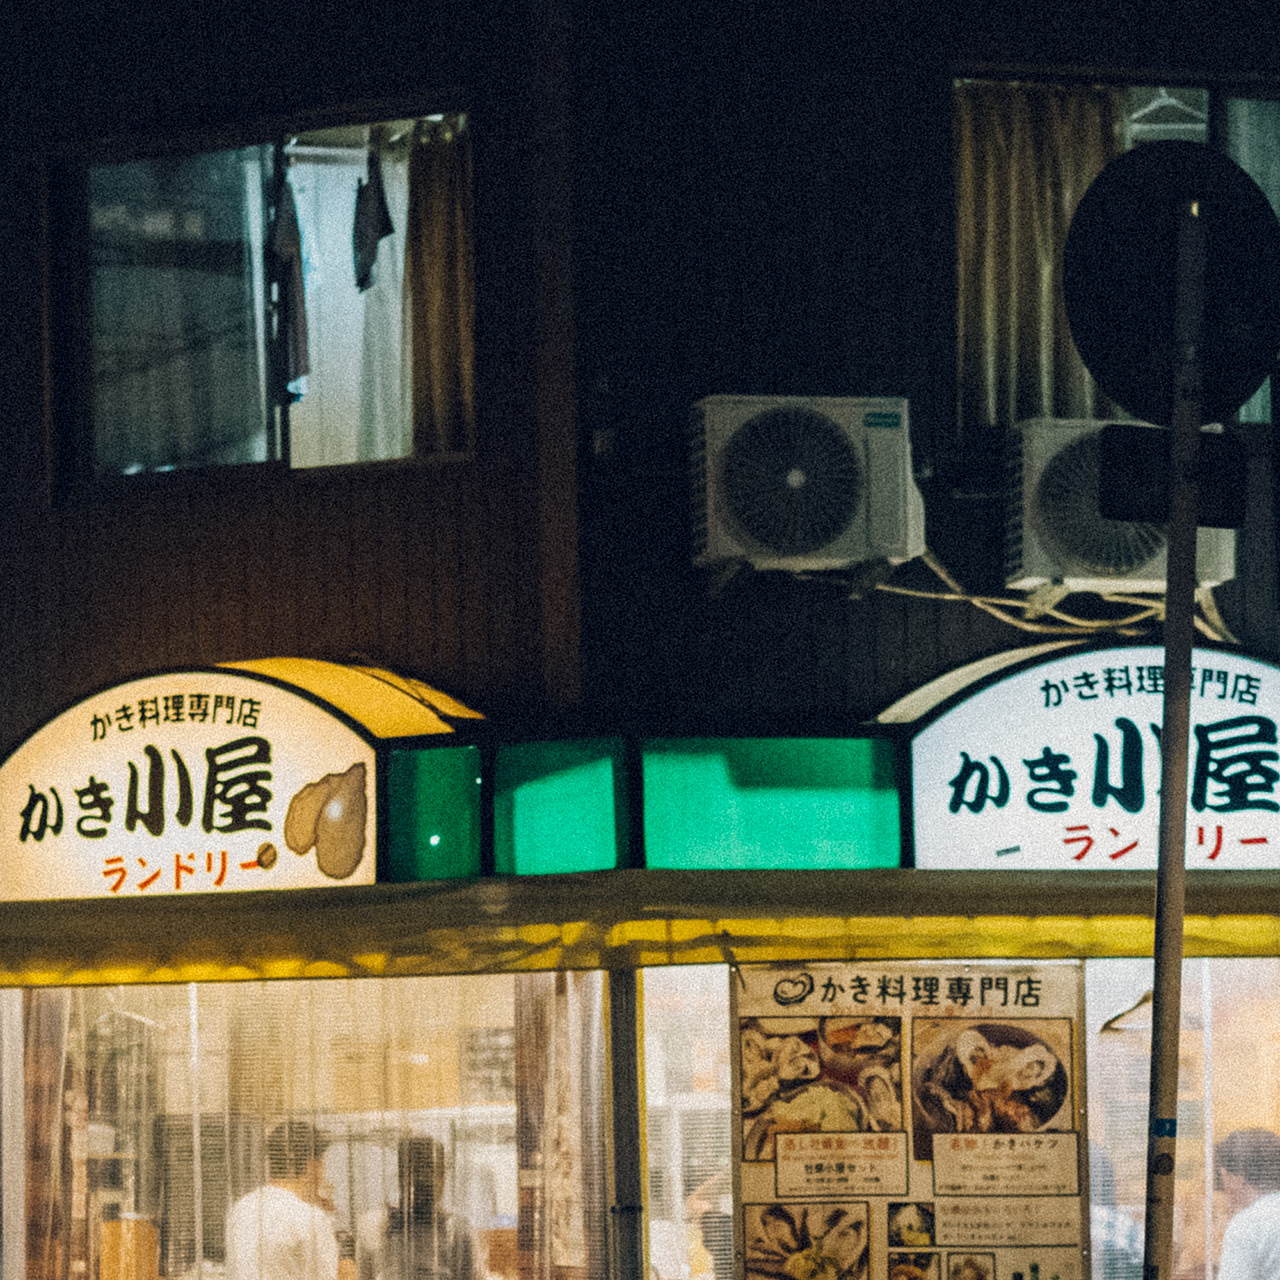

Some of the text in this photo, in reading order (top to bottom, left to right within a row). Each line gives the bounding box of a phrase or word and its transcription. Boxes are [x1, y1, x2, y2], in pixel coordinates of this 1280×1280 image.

[1040, 665, 1261, 707] かき料理門店
[91, 693, 262, 741] かき料理専門店
[948, 715, 1280, 814] かき小屋
[19, 736, 273, 842] かき小屋
[1062, 825, 1269, 861] ランリー
[101, 850, 265, 893] ランドリー
[820, 976, 1043, 1007] かき料理専門店
